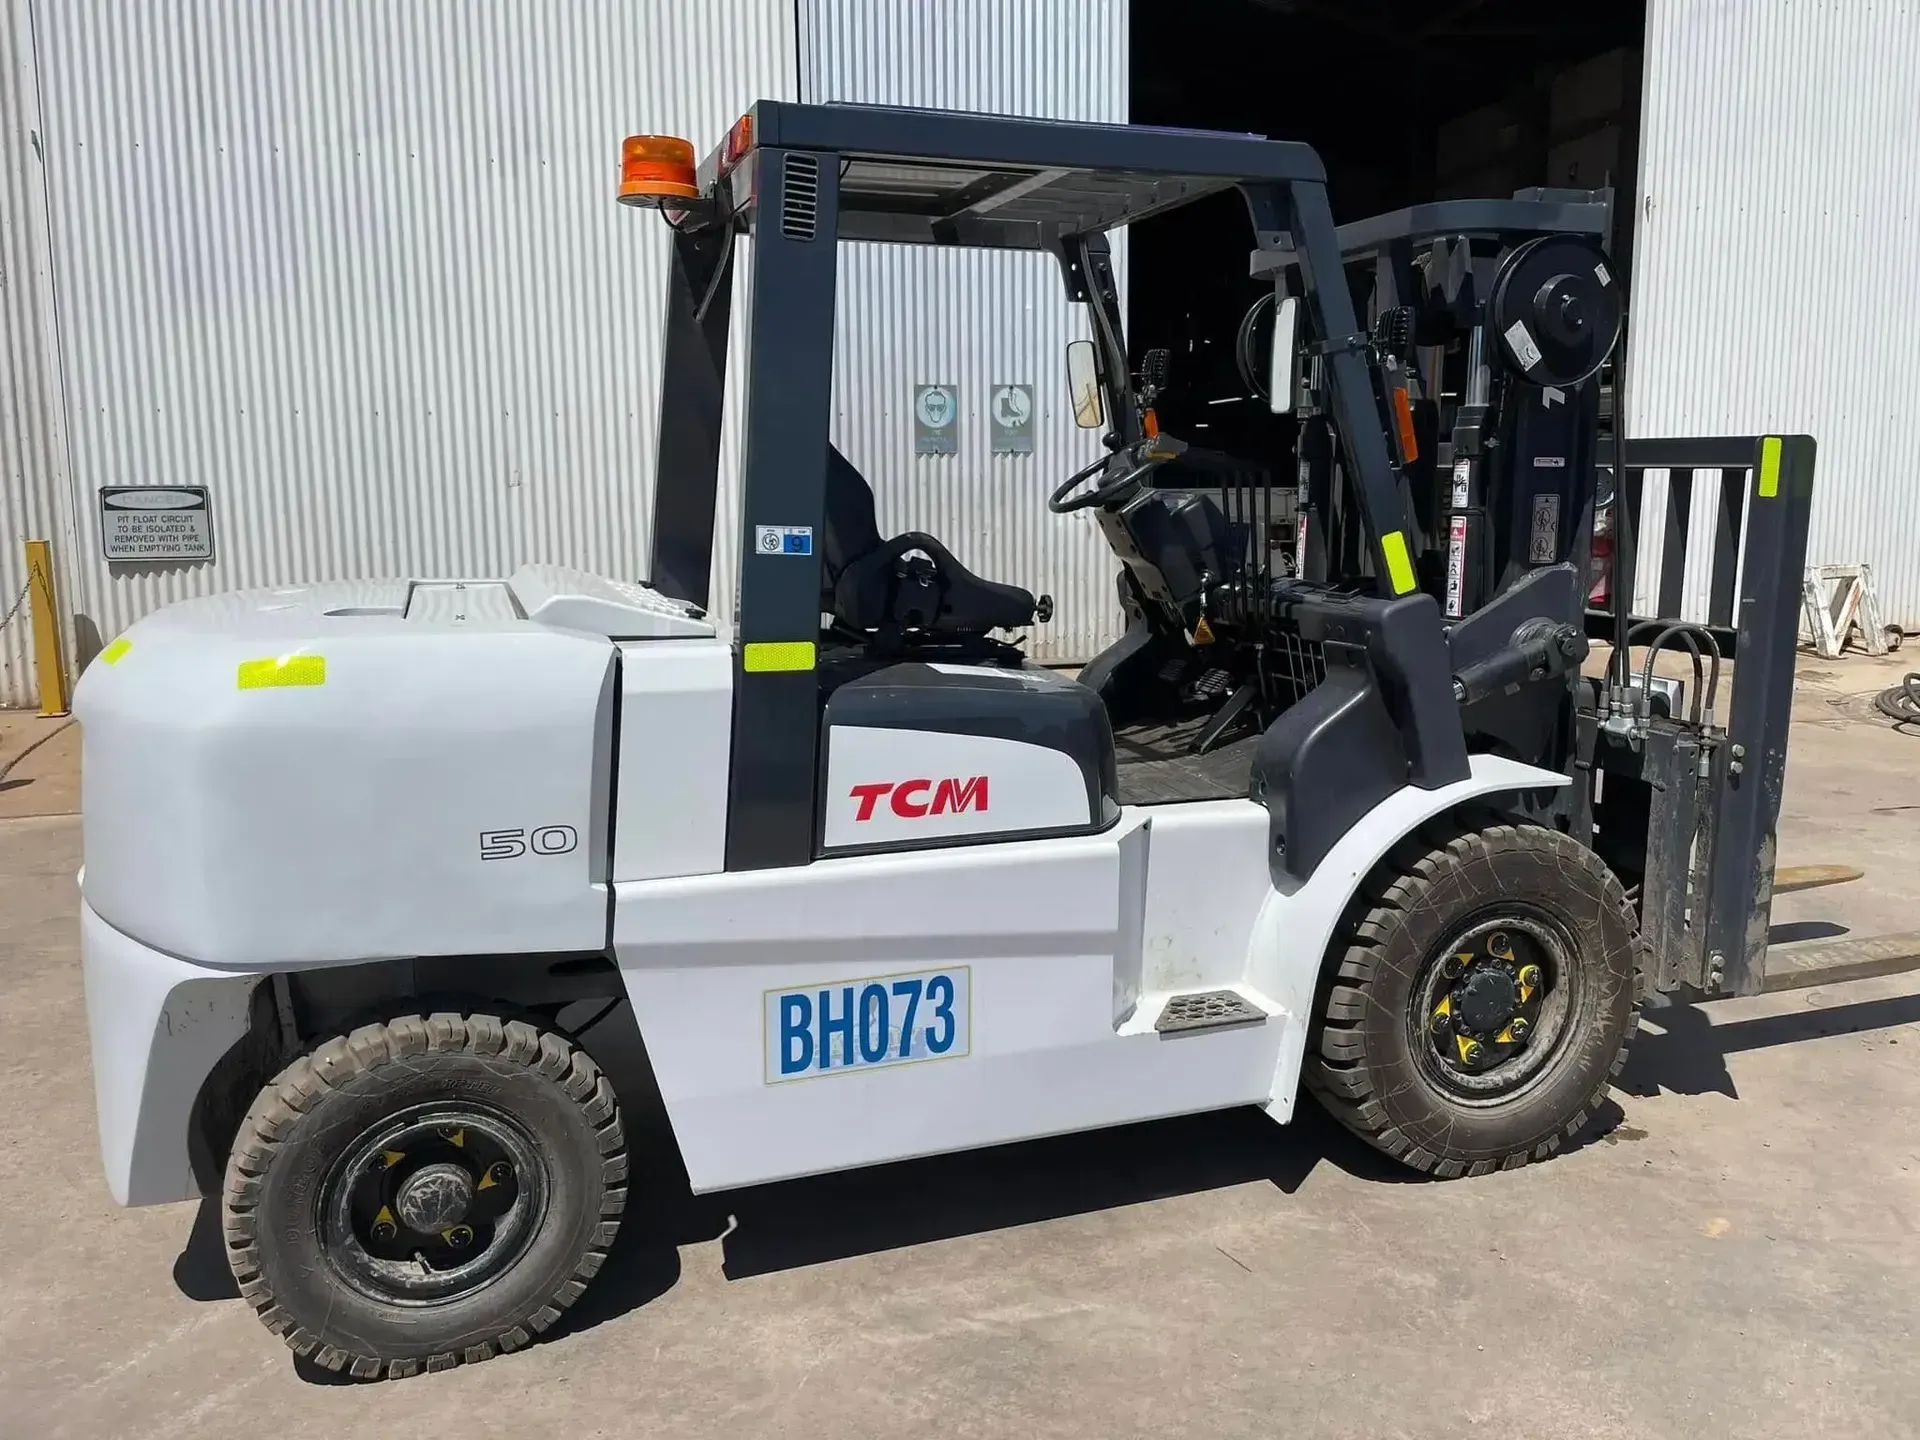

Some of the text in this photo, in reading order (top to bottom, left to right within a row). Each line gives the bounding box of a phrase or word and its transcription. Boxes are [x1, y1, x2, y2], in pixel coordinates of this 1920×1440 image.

[117, 515, 194, 524] PIT FLOAT CIRCUIT
[117, 525, 129, 533] TO
[132, 525, 143, 533] BE
[146, 525, 186, 533] ISOLATED
[114, 534, 200, 543] REMOVED WITH PIPE
[110, 544, 205, 553] WHEN EMPTYING TANK
[849, 775, 989, 821] TCM
[479, 823, 578, 861] 50
[780, 975, 956, 1075] BH073
